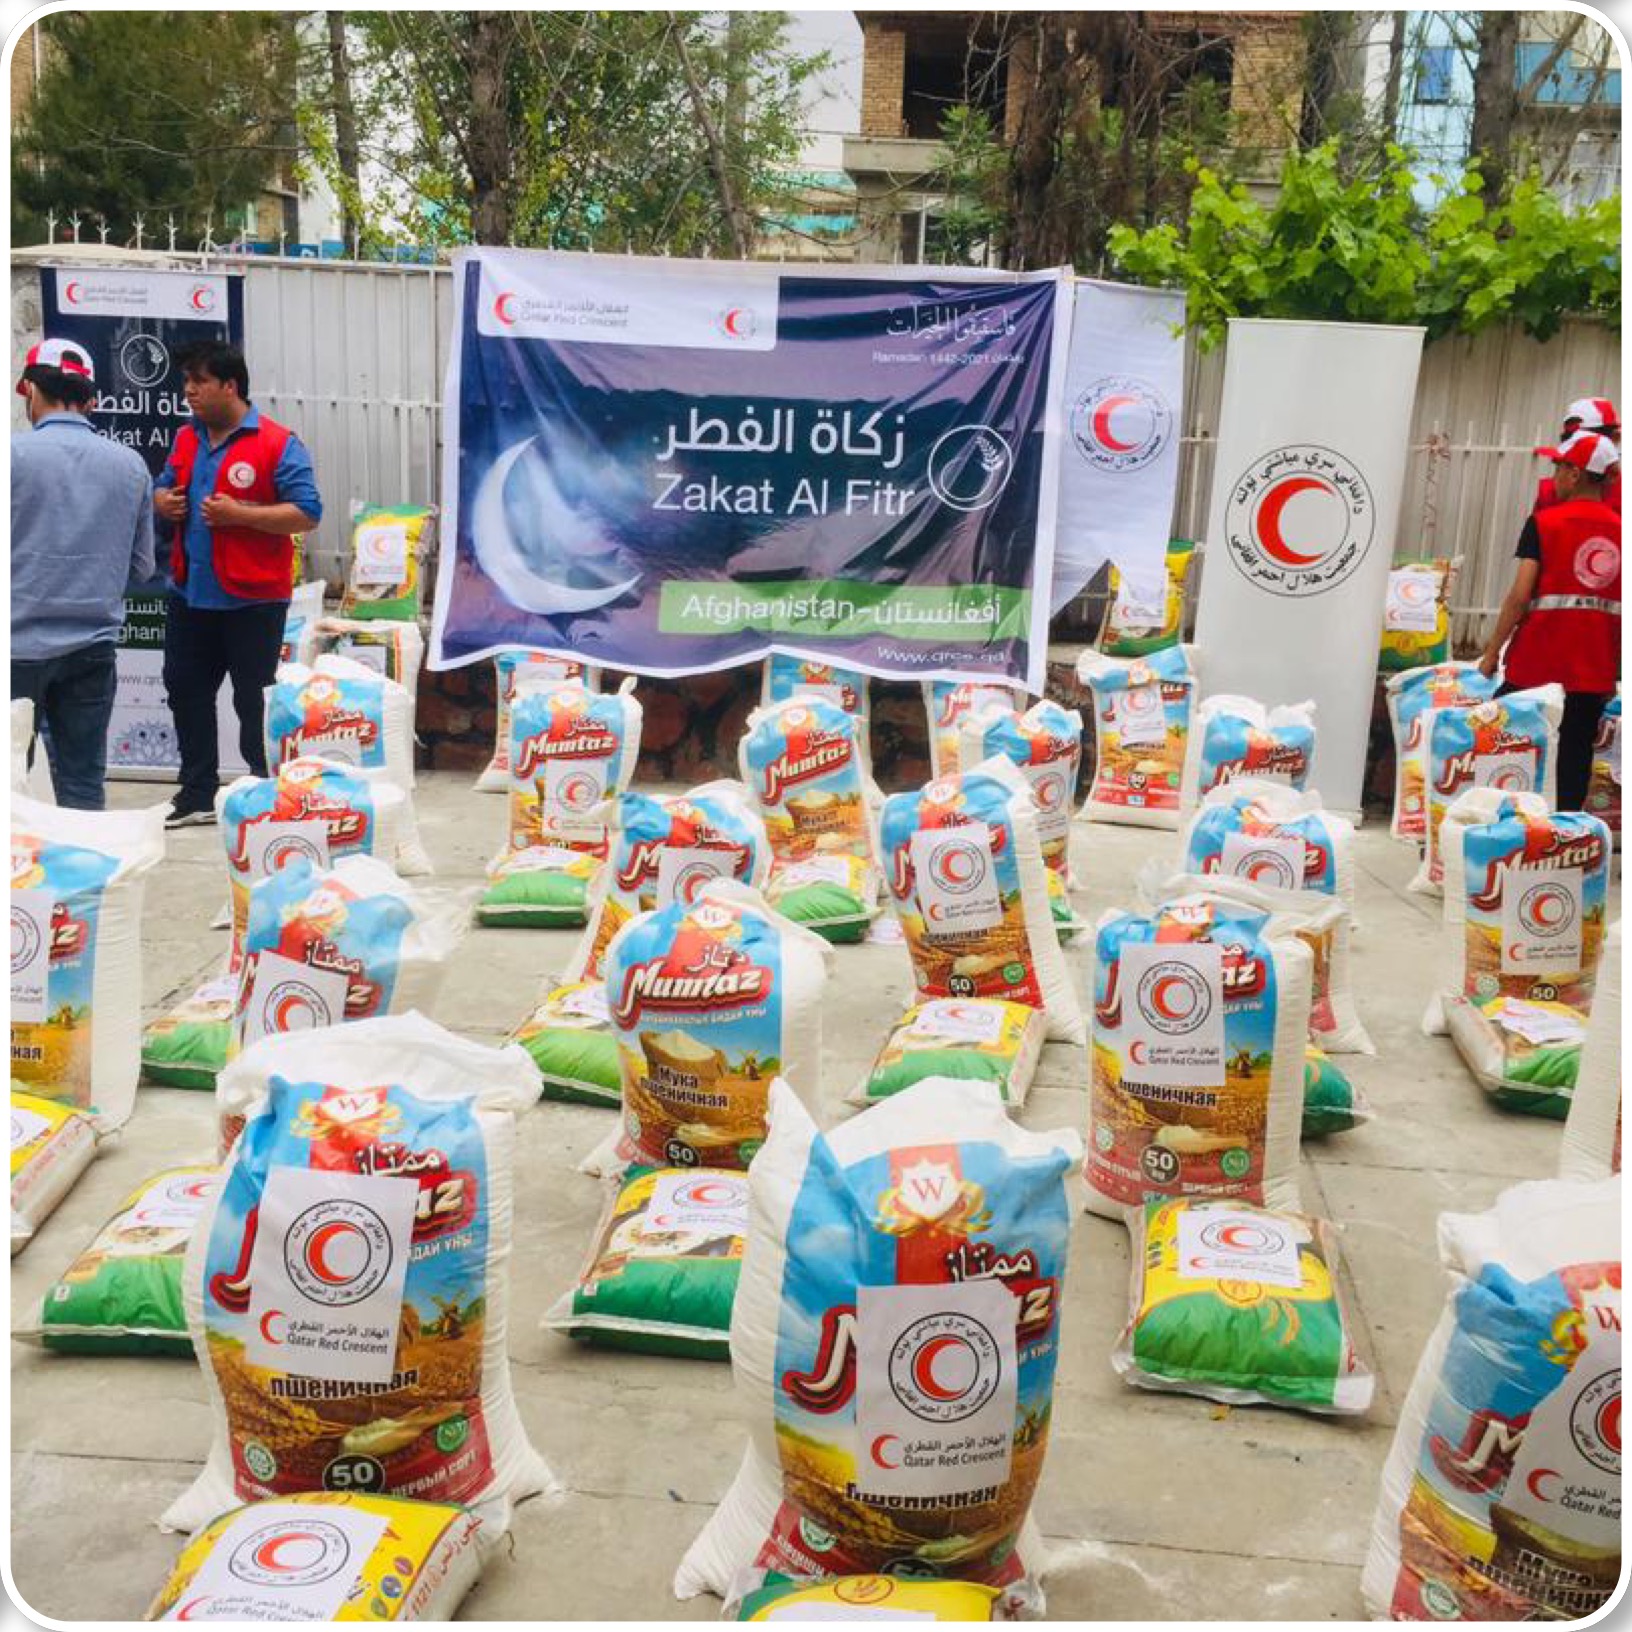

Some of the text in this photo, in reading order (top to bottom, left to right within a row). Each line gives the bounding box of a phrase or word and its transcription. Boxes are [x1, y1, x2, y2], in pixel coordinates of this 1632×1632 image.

[91, 388, 194, 416] كاة الفط
[96, 425, 169, 448] akat Al
[656, 405, 906, 468] زكاة الفطر
[652, 474, 916, 517] Zakat Al Fitr
[877, 645, 1005, 666] www.qrcs.qa
[518, 735, 614, 779] Mumtaz
[766, 741, 850, 802] Mumtaz
[303, 938, 363, 972] ممتاز
[618, 965, 764, 1025] Mumtaz
[354, 1141, 441, 1177] ممتاز
[668, 1142, 695, 1165] 50
[1146, 1150, 1174, 1170] 50
[911, 1175, 948, 1199] W
[945, 1250, 1032, 1283] ممتاز
[287, 1334, 388, 1355] Qatar Red Crescent
[903, 1448, 1005, 1468] Qatar Red Crescent
[330, 1461, 375, 1486] 50
[1560, 1496, 1596, 1516] Qatar
